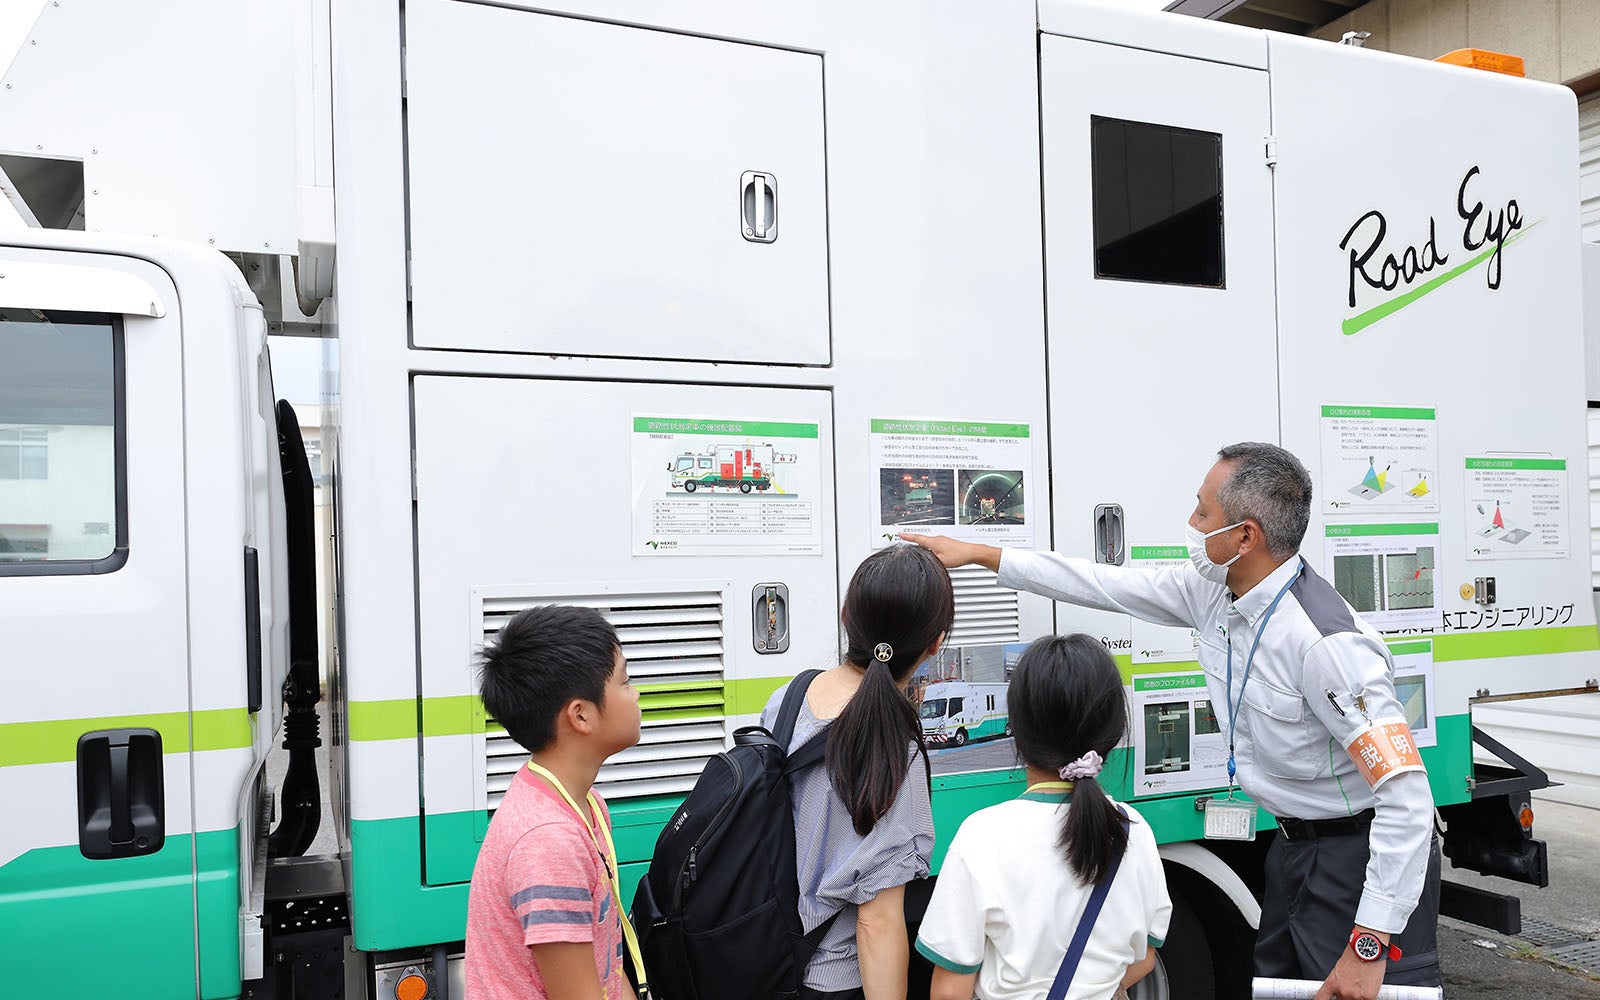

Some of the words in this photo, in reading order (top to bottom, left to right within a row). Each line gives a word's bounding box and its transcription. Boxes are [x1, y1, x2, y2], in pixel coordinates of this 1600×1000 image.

[1339, 210, 1450, 308] Road
[1457, 165, 1524, 290] Eye
[1101, 636, 1132, 650] Syste
[1359, 734, 1413, 770] 説明
